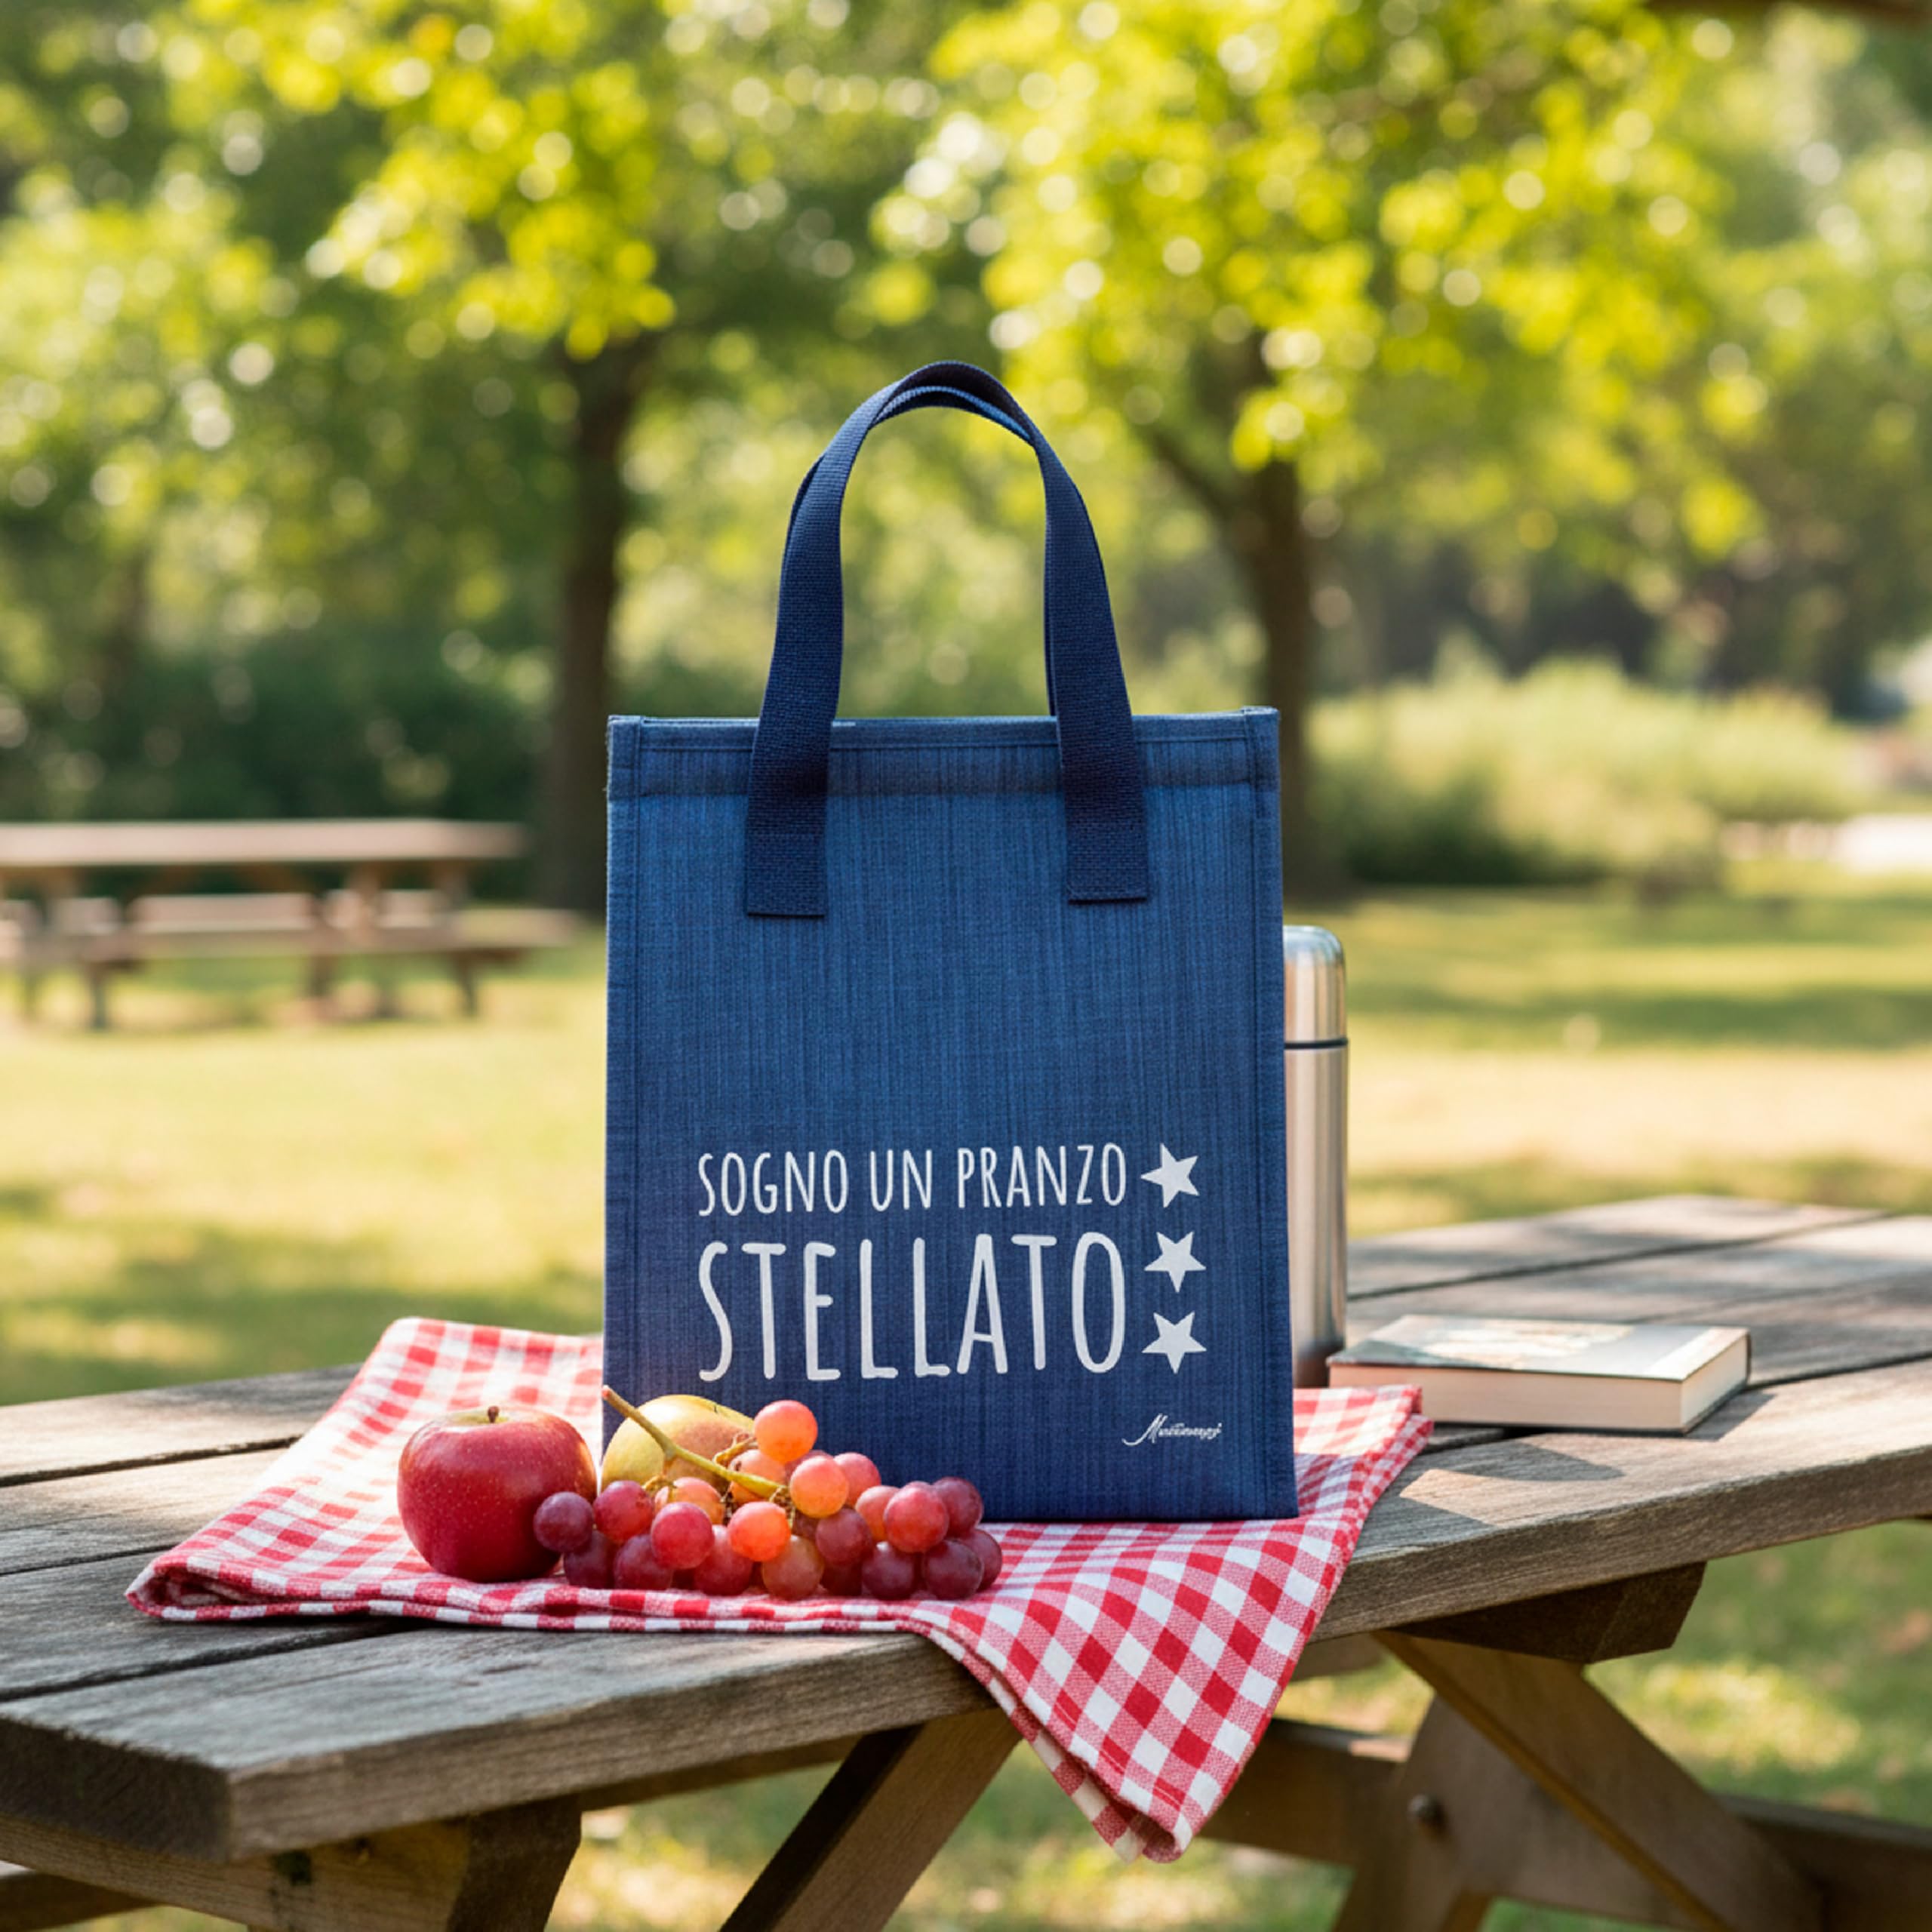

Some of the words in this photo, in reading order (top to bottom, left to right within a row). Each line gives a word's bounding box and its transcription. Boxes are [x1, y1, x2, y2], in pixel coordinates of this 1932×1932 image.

[698, 1150, 849, 1217] SOGNO
[869, 1149, 933, 1212] UN
[957, 1143, 1127, 1208] PRANZO
[698, 1232, 1126, 1383] STELLATO
